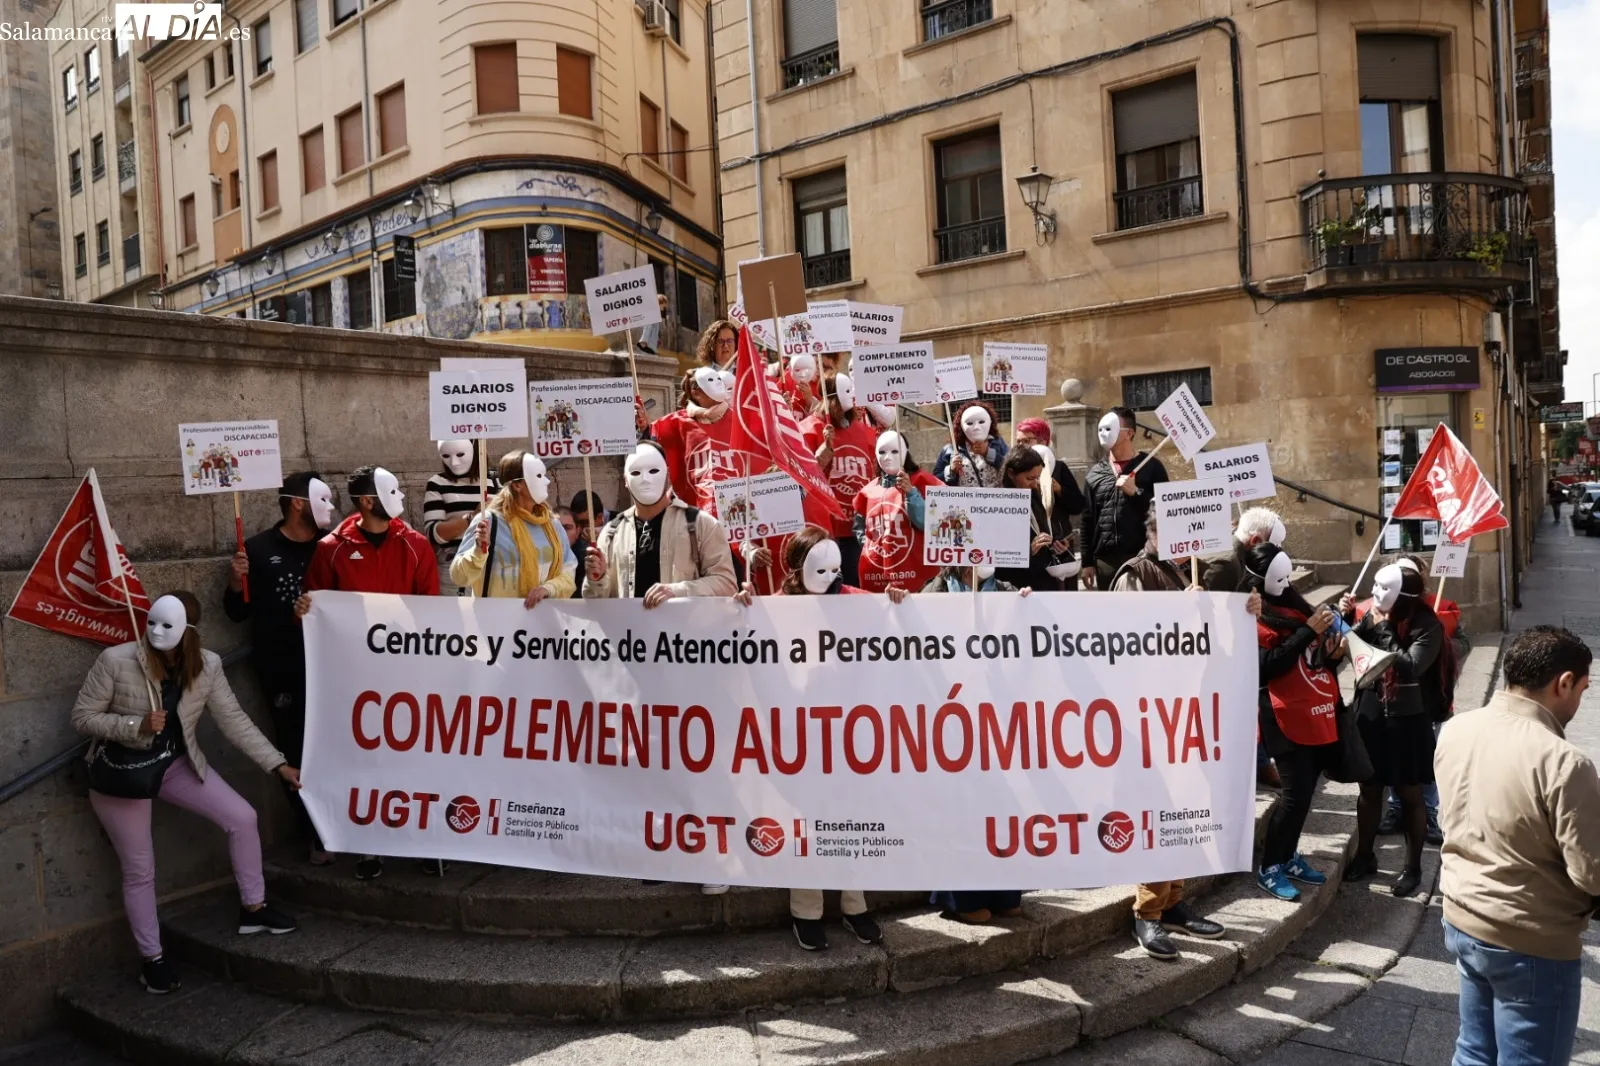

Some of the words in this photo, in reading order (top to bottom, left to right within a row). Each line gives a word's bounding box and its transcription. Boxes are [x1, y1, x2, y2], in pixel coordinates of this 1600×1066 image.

[595, 278, 647, 298] SALARIOS
[603, 295, 643, 312] DIGNOS
[731, 307, 746, 323] UG
[808, 311, 848, 320] DISCAPACIDAD
[606, 318, 621, 328] UGT
[784, 342, 810, 355] UGT
[859, 349, 927, 361] COMPLEMENTO
[1385, 356, 1404, 366] DE
[1406, 354, 1454, 365] CASTRO
[1409, 370, 1456, 378] ABOGADOS
[530, 384, 577, 392] Profesionales
[579, 381, 632, 391] imprescindibles
[887, 376, 905, 387] ¡YA!
[984, 382, 1009, 392] UGT
[442, 383, 514, 395] SALARIOS
[575, 396, 633, 405] DISCAPACIDAD
[867, 392, 889, 402] UGT
[451, 402, 507, 414] DIGNOS
[1180, 391, 1210, 436] COMPLEMENTO
[1161, 413, 1174, 430] UGT
[451, 424, 473, 434] UGT
[224, 432, 278, 441] DISCAPACIDAD
[237, 449, 254, 457] UGT
[536, 440, 574, 457] UGT
[1204, 454, 1260, 471] SALARIOS
[1227, 470, 1257, 483] GNOS
[751, 484, 798, 497] DISCAPACIDAD
[926, 490, 973, 498] Profesionales
[975, 492, 1030, 500] imprescindibles
[1161, 487, 1224, 502] COMPLEMENTO
[970, 506, 1029, 515] DISCAPACIDAD
[1188, 521, 1205, 534] ¡YA!
[1170, 541, 1190, 554] UGT
[926, 547, 965, 564] UGT
[35, 601, 129, 642] www.ugt.es
[366, 623, 478, 657] Centros
[487, 635, 504, 666] y
[512, 629, 611, 663] Servicios
[617, 629, 646, 663] de
[653, 629, 779, 664] Atención
[789, 638, 807, 663] a
[818, 630, 956, 663] Personas
[965, 631, 1020, 660] con
[1030, 622, 1211, 665] Discapacidad
[351, 690, 715, 774] COMPLEMENTO
[731, 683, 1123, 775] AUTONÓMICO
[1138, 692, 1221, 769] ¡YA!
[348, 787, 440, 830] UGT
[507, 801, 566, 816] Enseñanza
[1159, 808, 1210, 822] Enseñanza
[506, 817, 543, 829] Servicios
[545, 819, 580, 831] Públicos
[815, 820, 885, 832] Enseñanza
[1159, 825, 1193, 836] Servicios
[1195, 823, 1223, 833] Públicos
[504, 827, 535, 838] Castilla
[536, 832, 542, 840] y
[544, 831, 563, 840] León
[644, 811, 736, 854] UGT
[985, 813, 1088, 858] UGT
[816, 836, 860, 846] Servicios
[862, 836, 904, 846] Públicos
[1159, 836, 1188, 847] Castilla
[1189, 838, 1195, 847] y
[1195, 835, 1211, 845] León
[816, 847, 852, 857] Castilla
[853, 850, 860, 859] y
[862, 847, 886, 857] León
